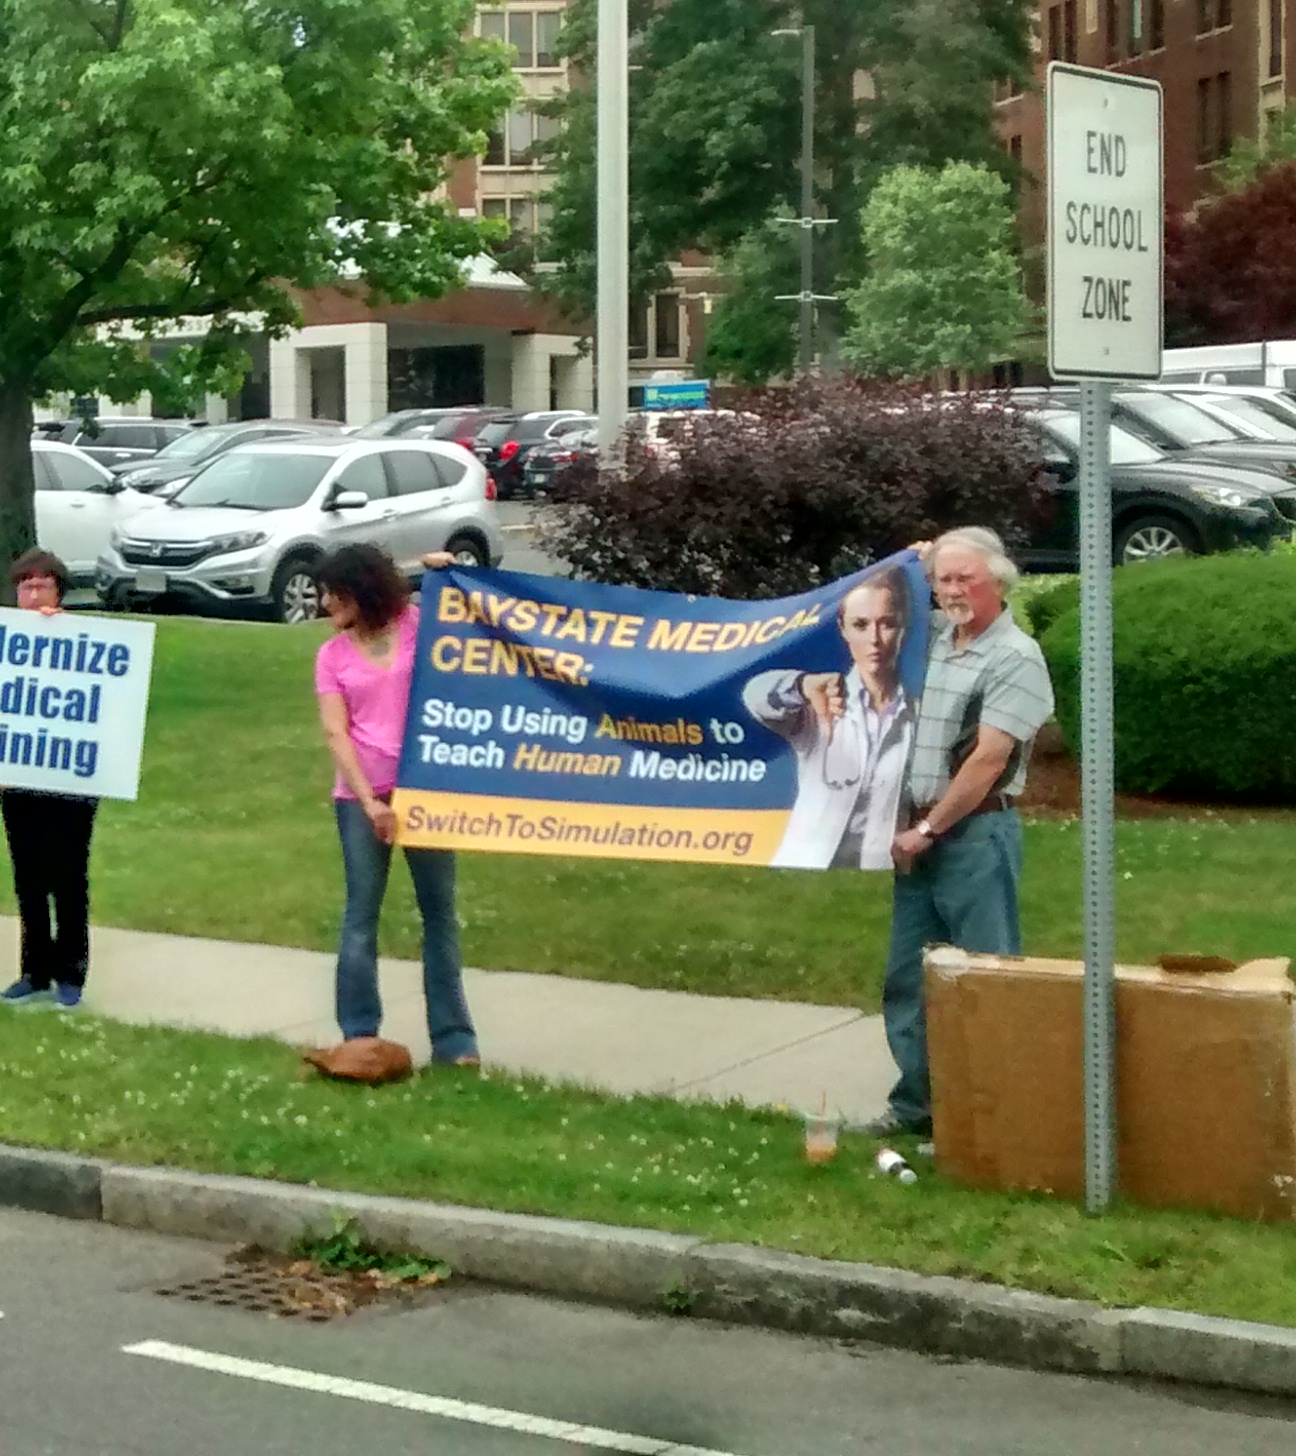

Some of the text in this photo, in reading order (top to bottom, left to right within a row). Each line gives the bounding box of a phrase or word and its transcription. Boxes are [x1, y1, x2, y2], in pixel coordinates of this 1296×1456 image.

[1086, 130, 1126, 178] END
[1065, 200, 1148, 253] SCHOOL
[1081, 276, 1132, 322] ZONE
[437, 586, 822, 653] BAYSTATE MEDICAL
[430, 635, 596, 686] CENTER:
[422, 698, 745, 745] Stop Using Animals to
[418, 734, 767, 782] Teach Human Medicine
[406, 805, 754, 856] SwitchToSimulation.org
